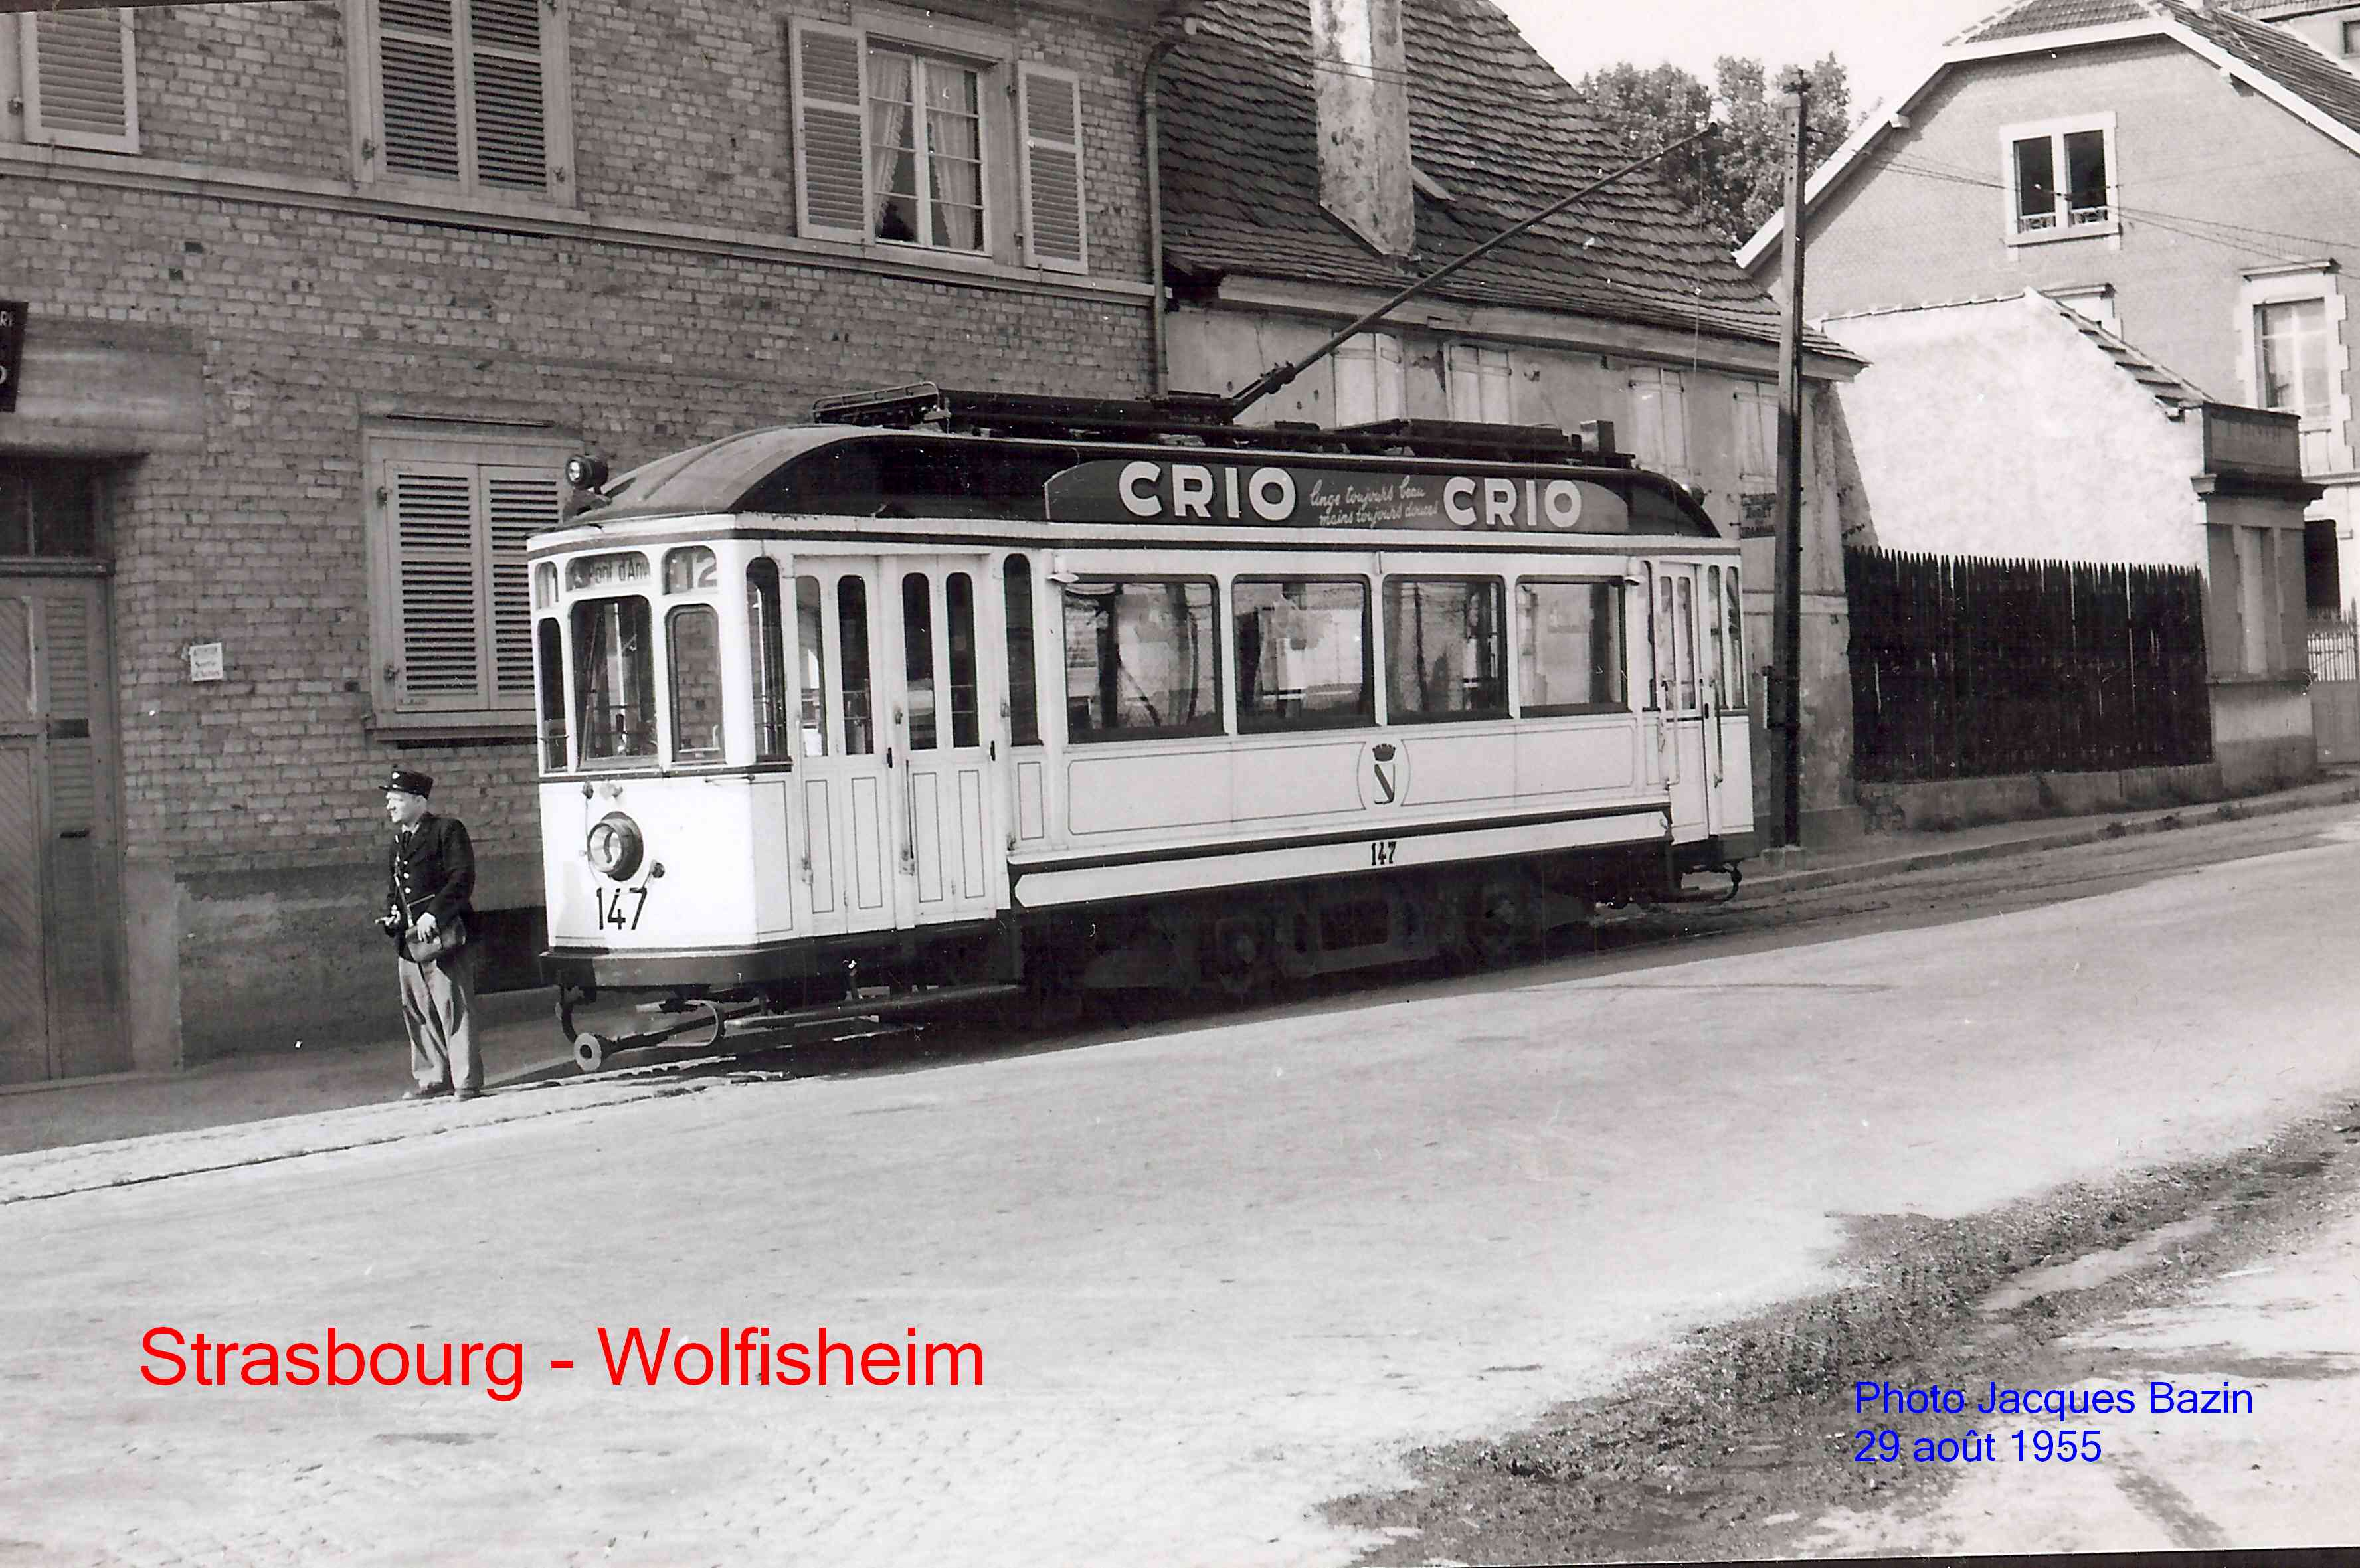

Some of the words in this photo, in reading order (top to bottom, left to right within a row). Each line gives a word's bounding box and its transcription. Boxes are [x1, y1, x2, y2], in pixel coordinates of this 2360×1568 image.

[1119, 461, 1296, 521] CRIO
[1310, 479, 1341, 515] linge
[1346, 485, 1394, 510] toujours
[1399, 474, 1426, 499] beau
[1443, 476, 1583, 528] CRIO
[1319, 509, 1354, 526] mains
[1356, 502, 1402, 529] toujours
[1371, 841, 1397, 866] 147
[596, 887, 648, 930] 147
